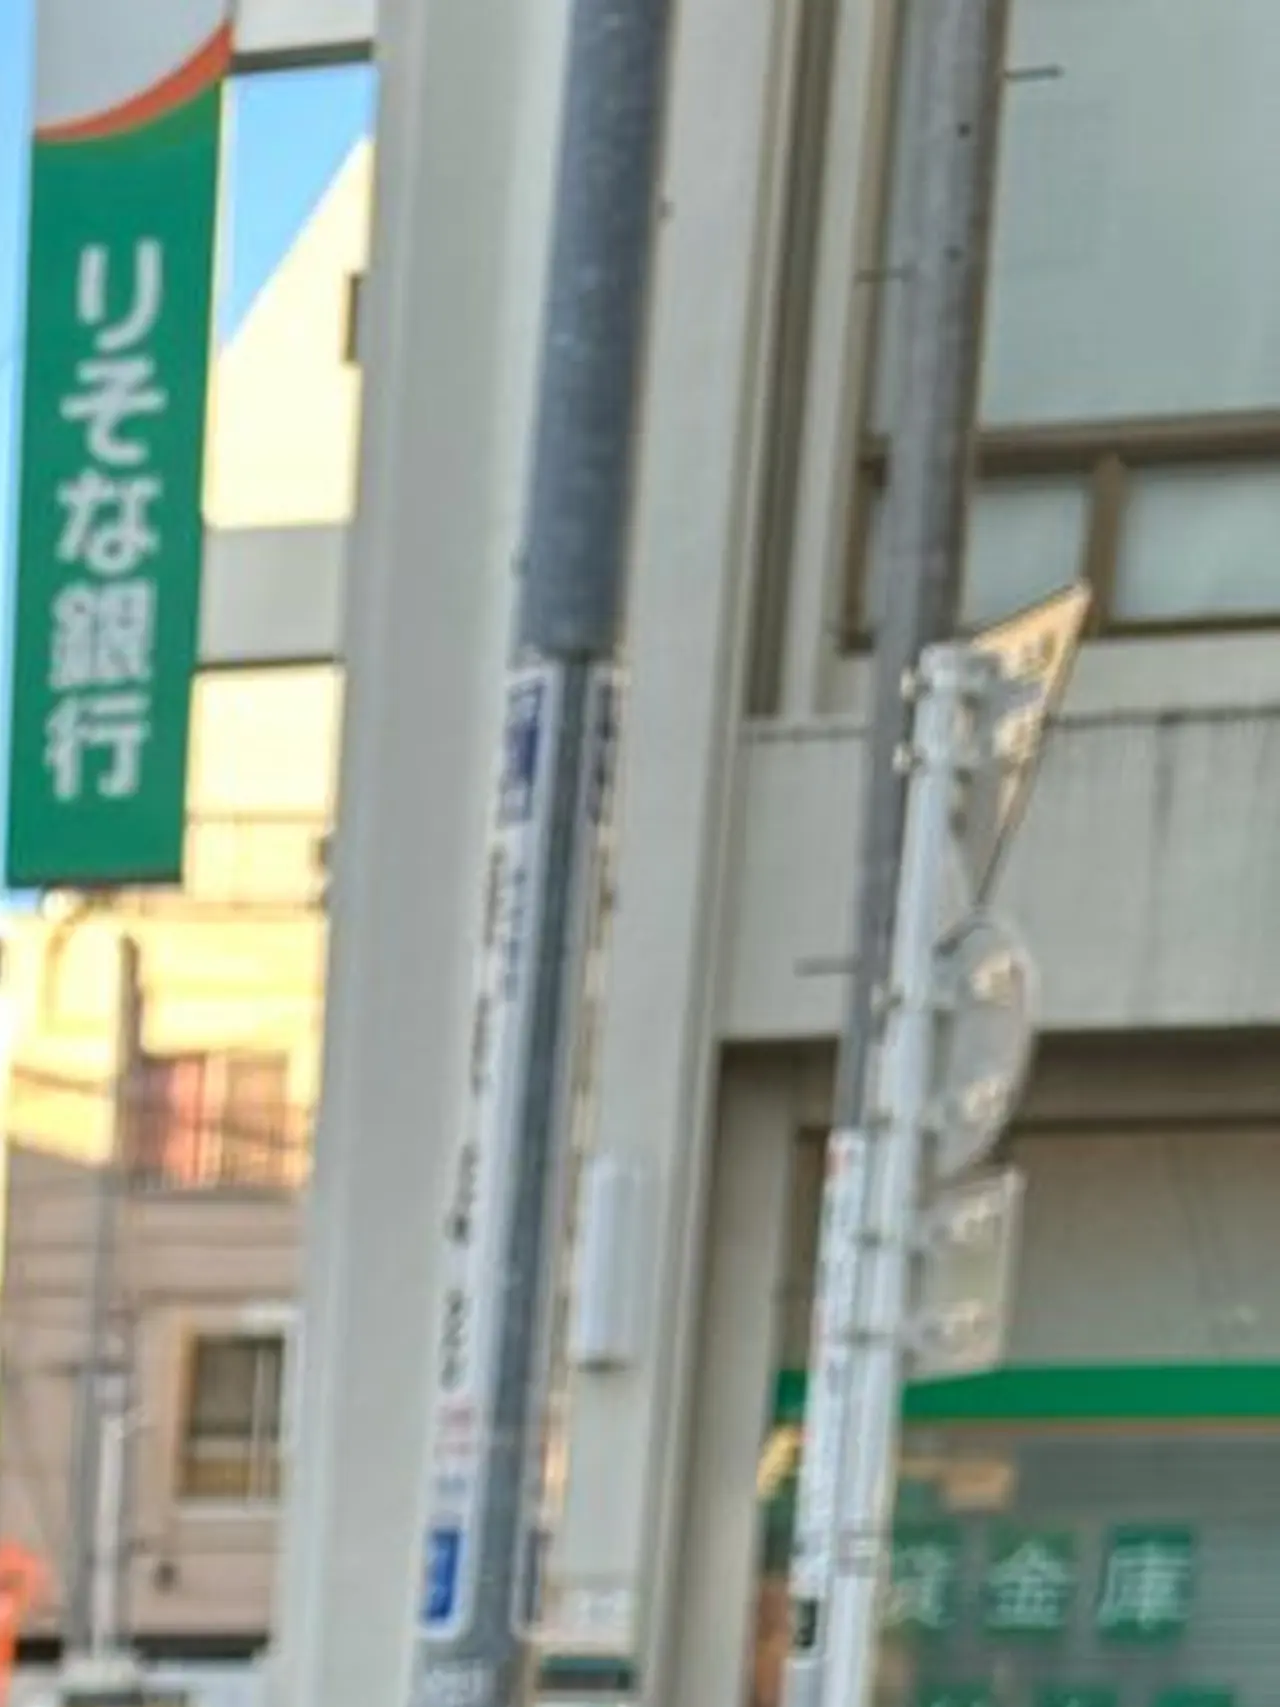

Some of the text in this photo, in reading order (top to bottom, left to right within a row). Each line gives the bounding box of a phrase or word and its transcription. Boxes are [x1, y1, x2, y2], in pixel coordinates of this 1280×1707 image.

[45, 238, 167, 800] りそな銀行
